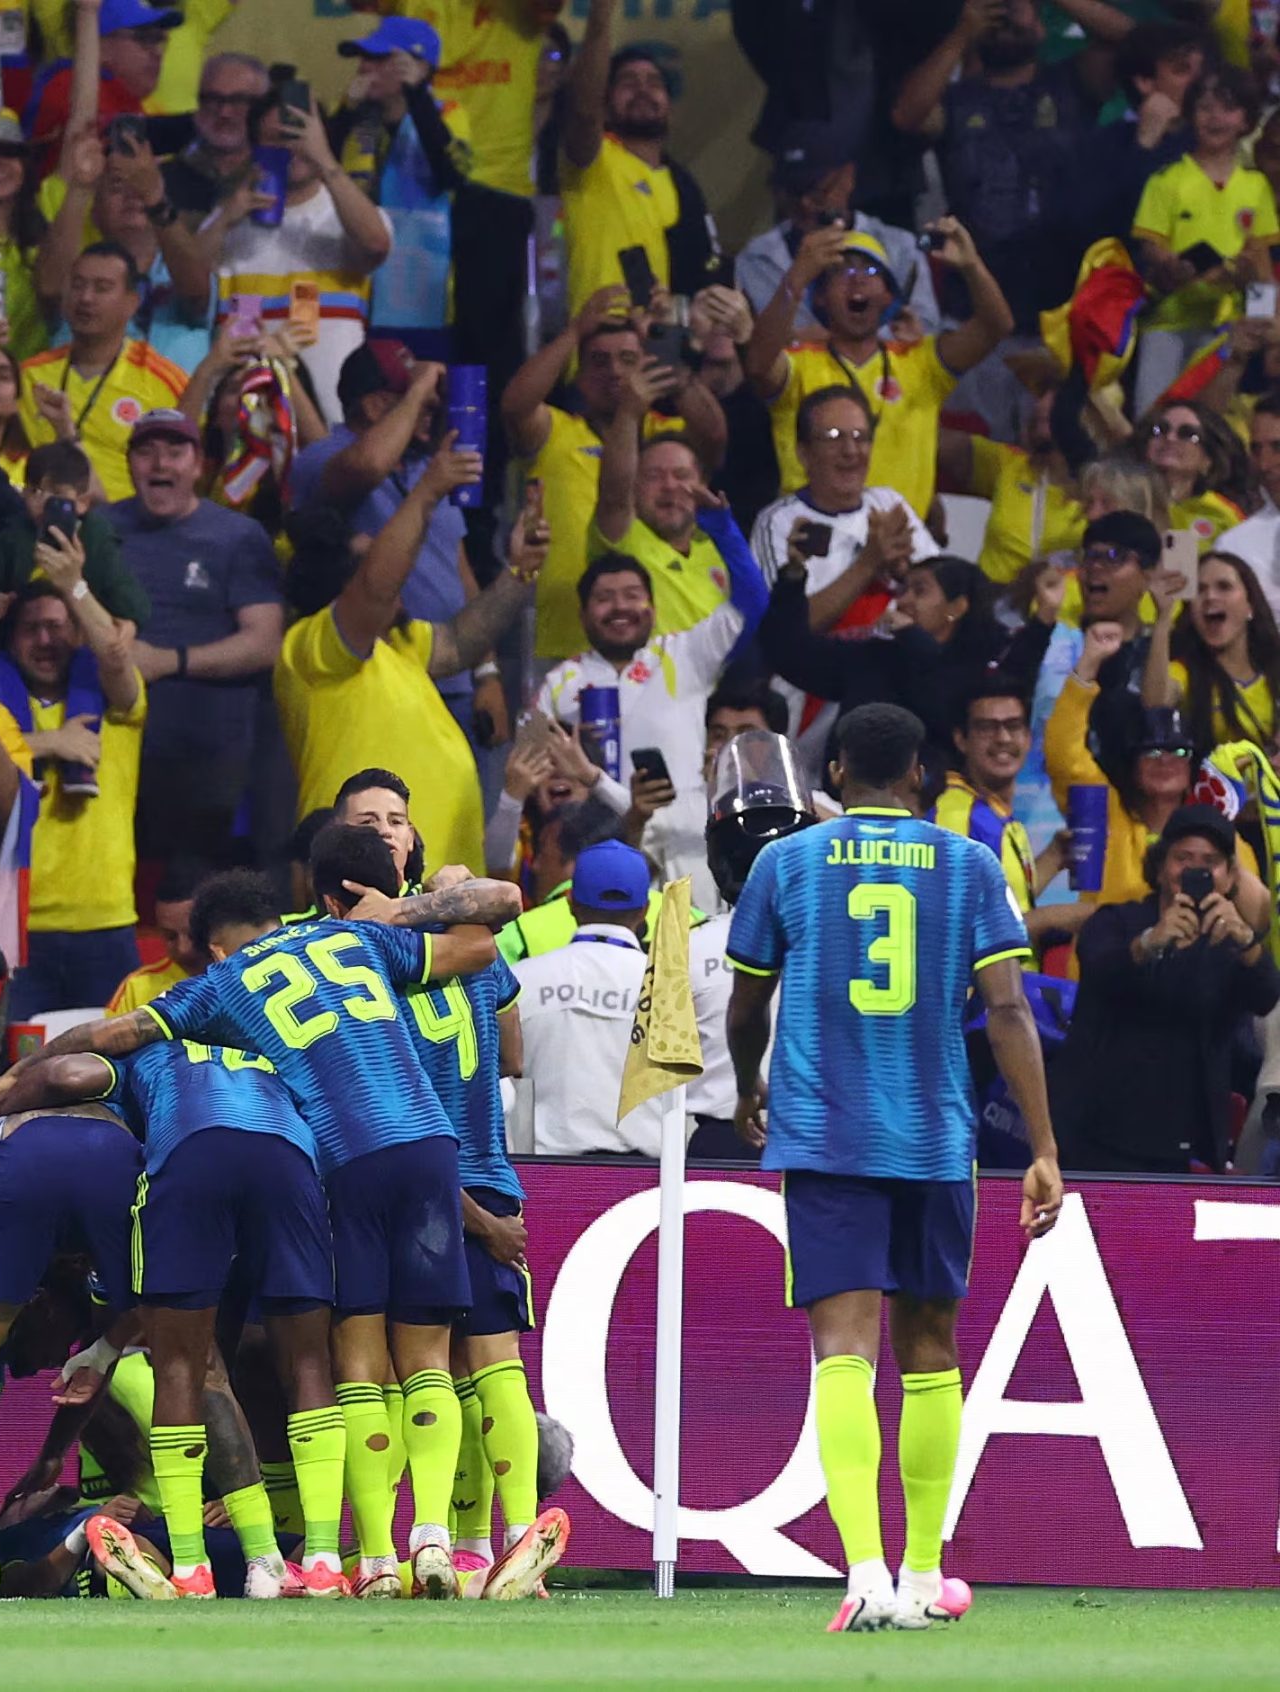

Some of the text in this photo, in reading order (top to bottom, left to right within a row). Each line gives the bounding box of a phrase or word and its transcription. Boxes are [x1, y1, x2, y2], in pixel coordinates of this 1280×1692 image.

[826, 838, 935, 869] J.LUCUMI
[241, 932, 396, 1049] 25
[540, 984, 640, 1012] POLICÍ
[848, 883, 916, 1016] 3
[407, 976, 478, 1080] 4
[542, 1180, 1280, 1579] QA
